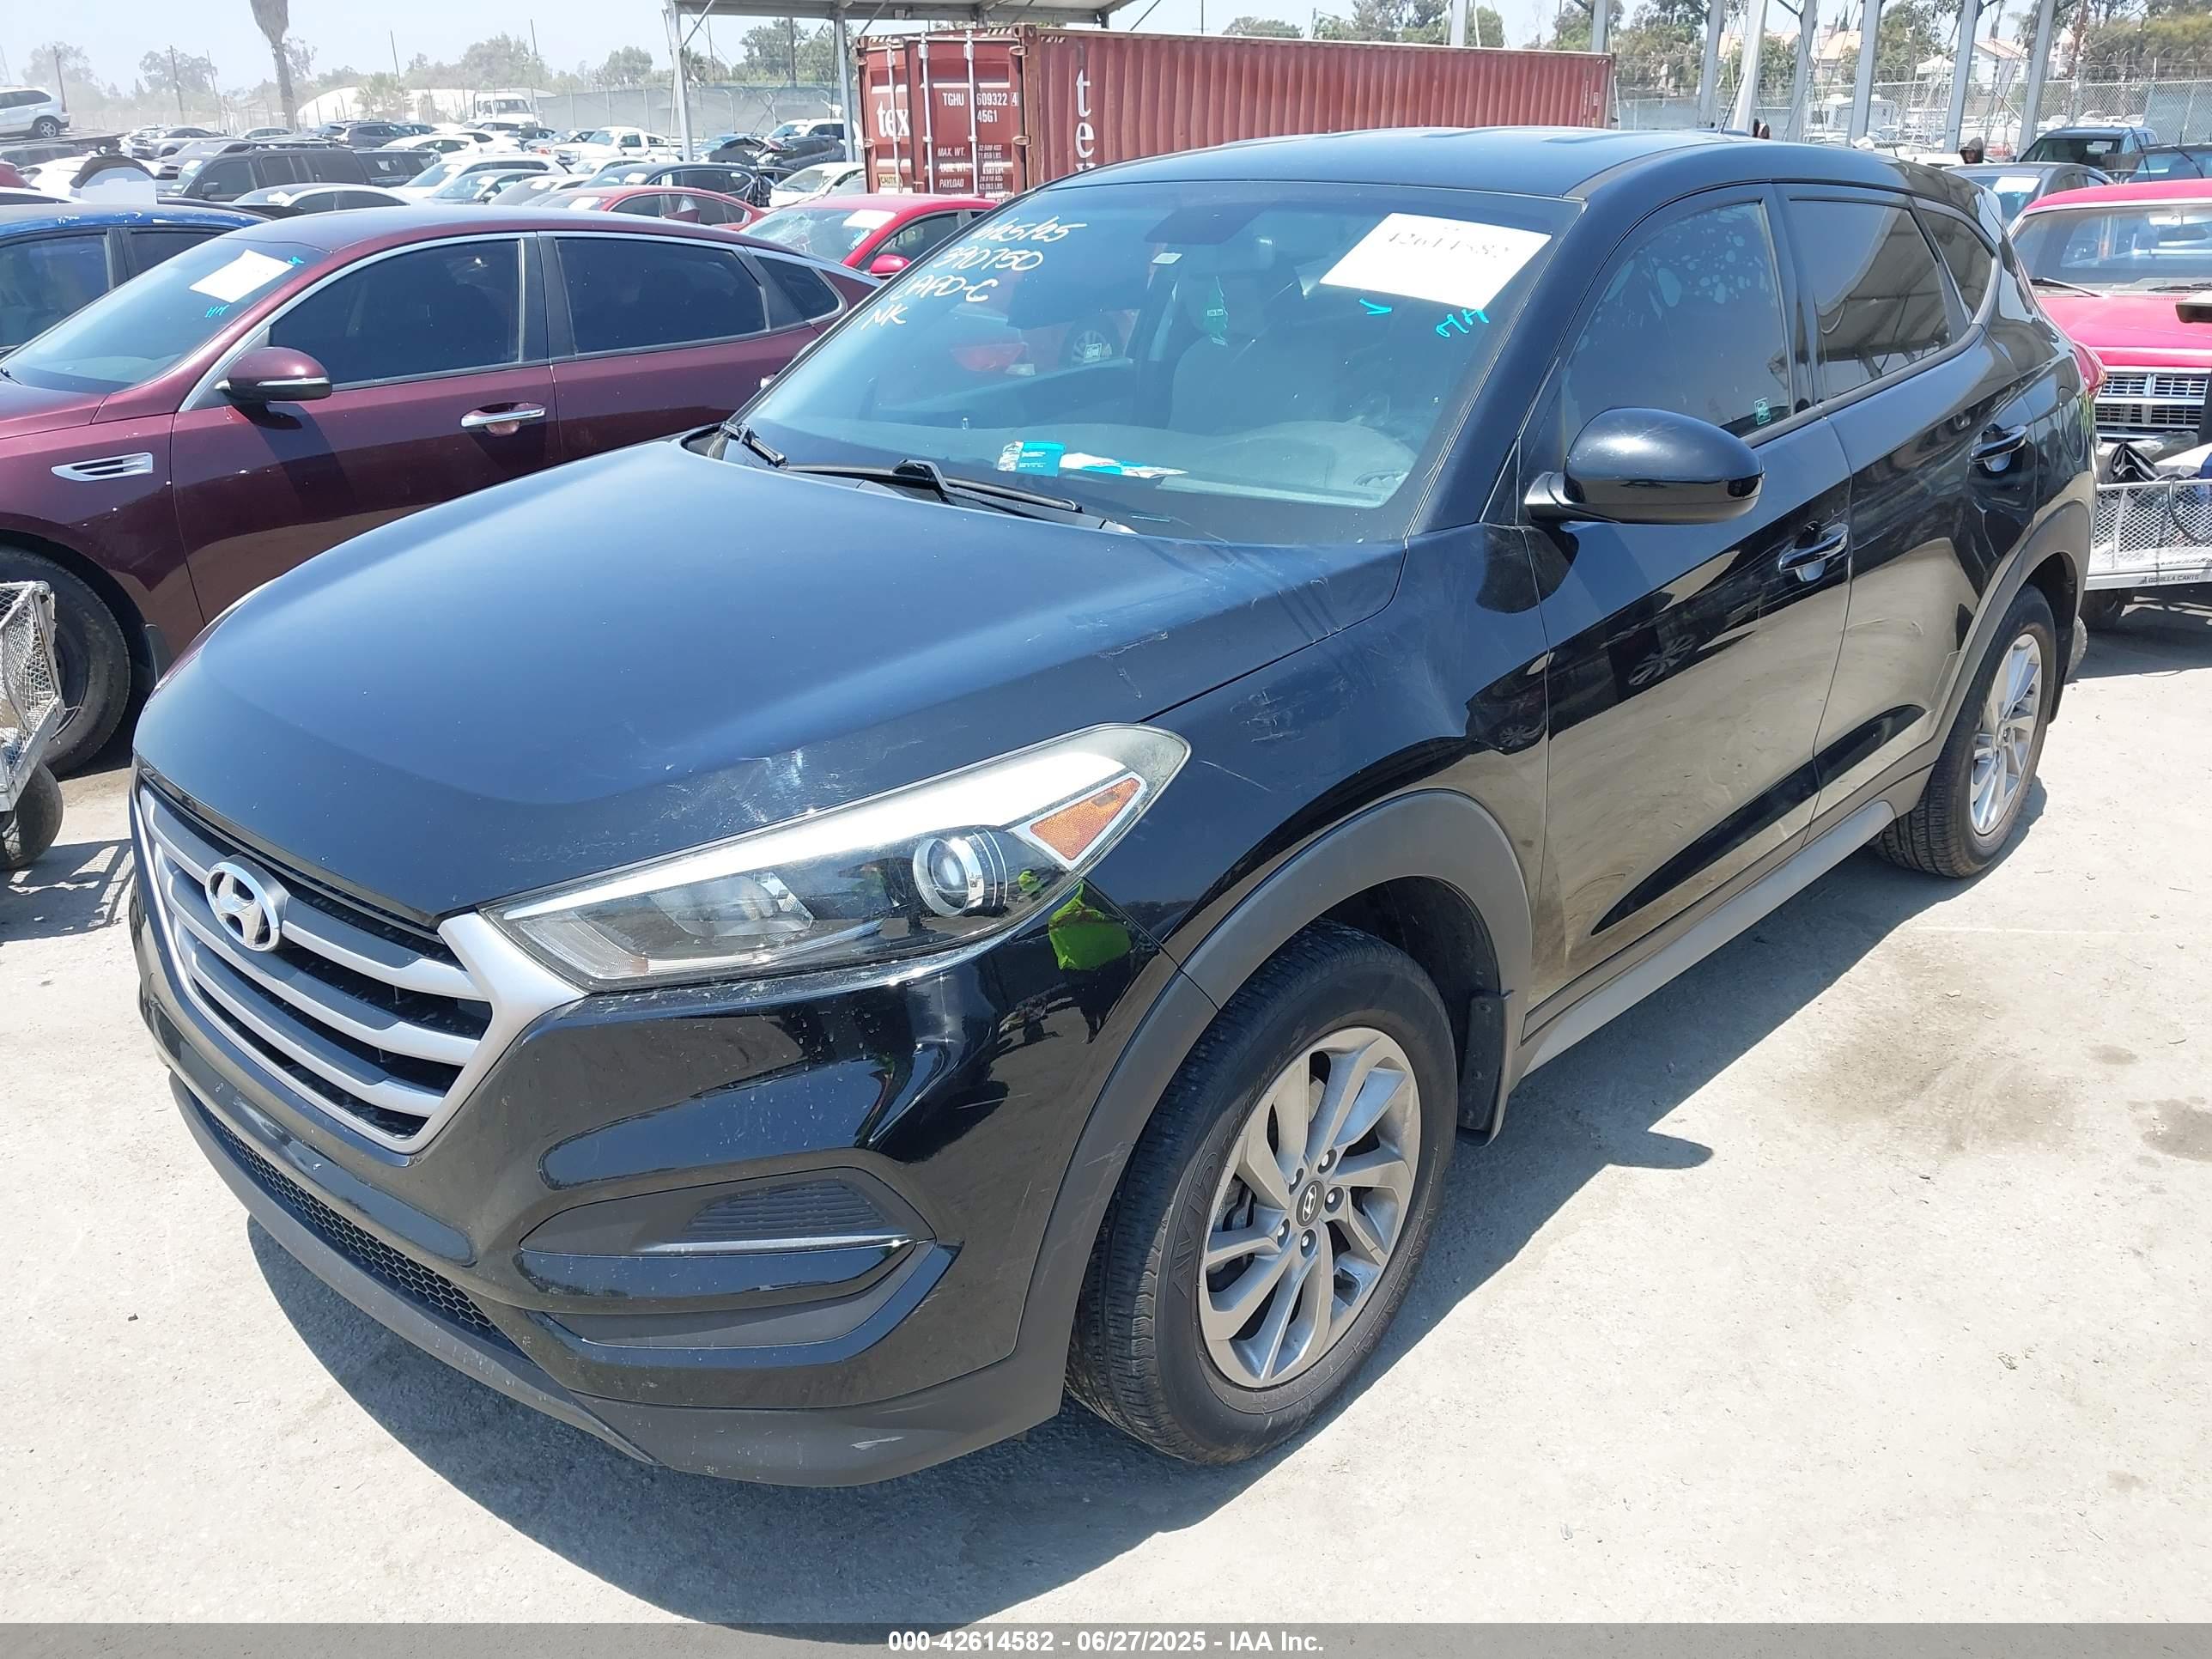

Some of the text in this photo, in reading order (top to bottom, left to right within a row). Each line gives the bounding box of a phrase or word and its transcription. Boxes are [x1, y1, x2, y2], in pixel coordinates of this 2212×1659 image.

[942, 93, 965, 106] TGHU
[976, 93, 1008, 106] 609322
[977, 110, 998, 123] 45G1
[1076, 69, 1097, 172] te
[954, 147, 966, 156] WT.
[939, 179, 964, 188] PAYLOAD
